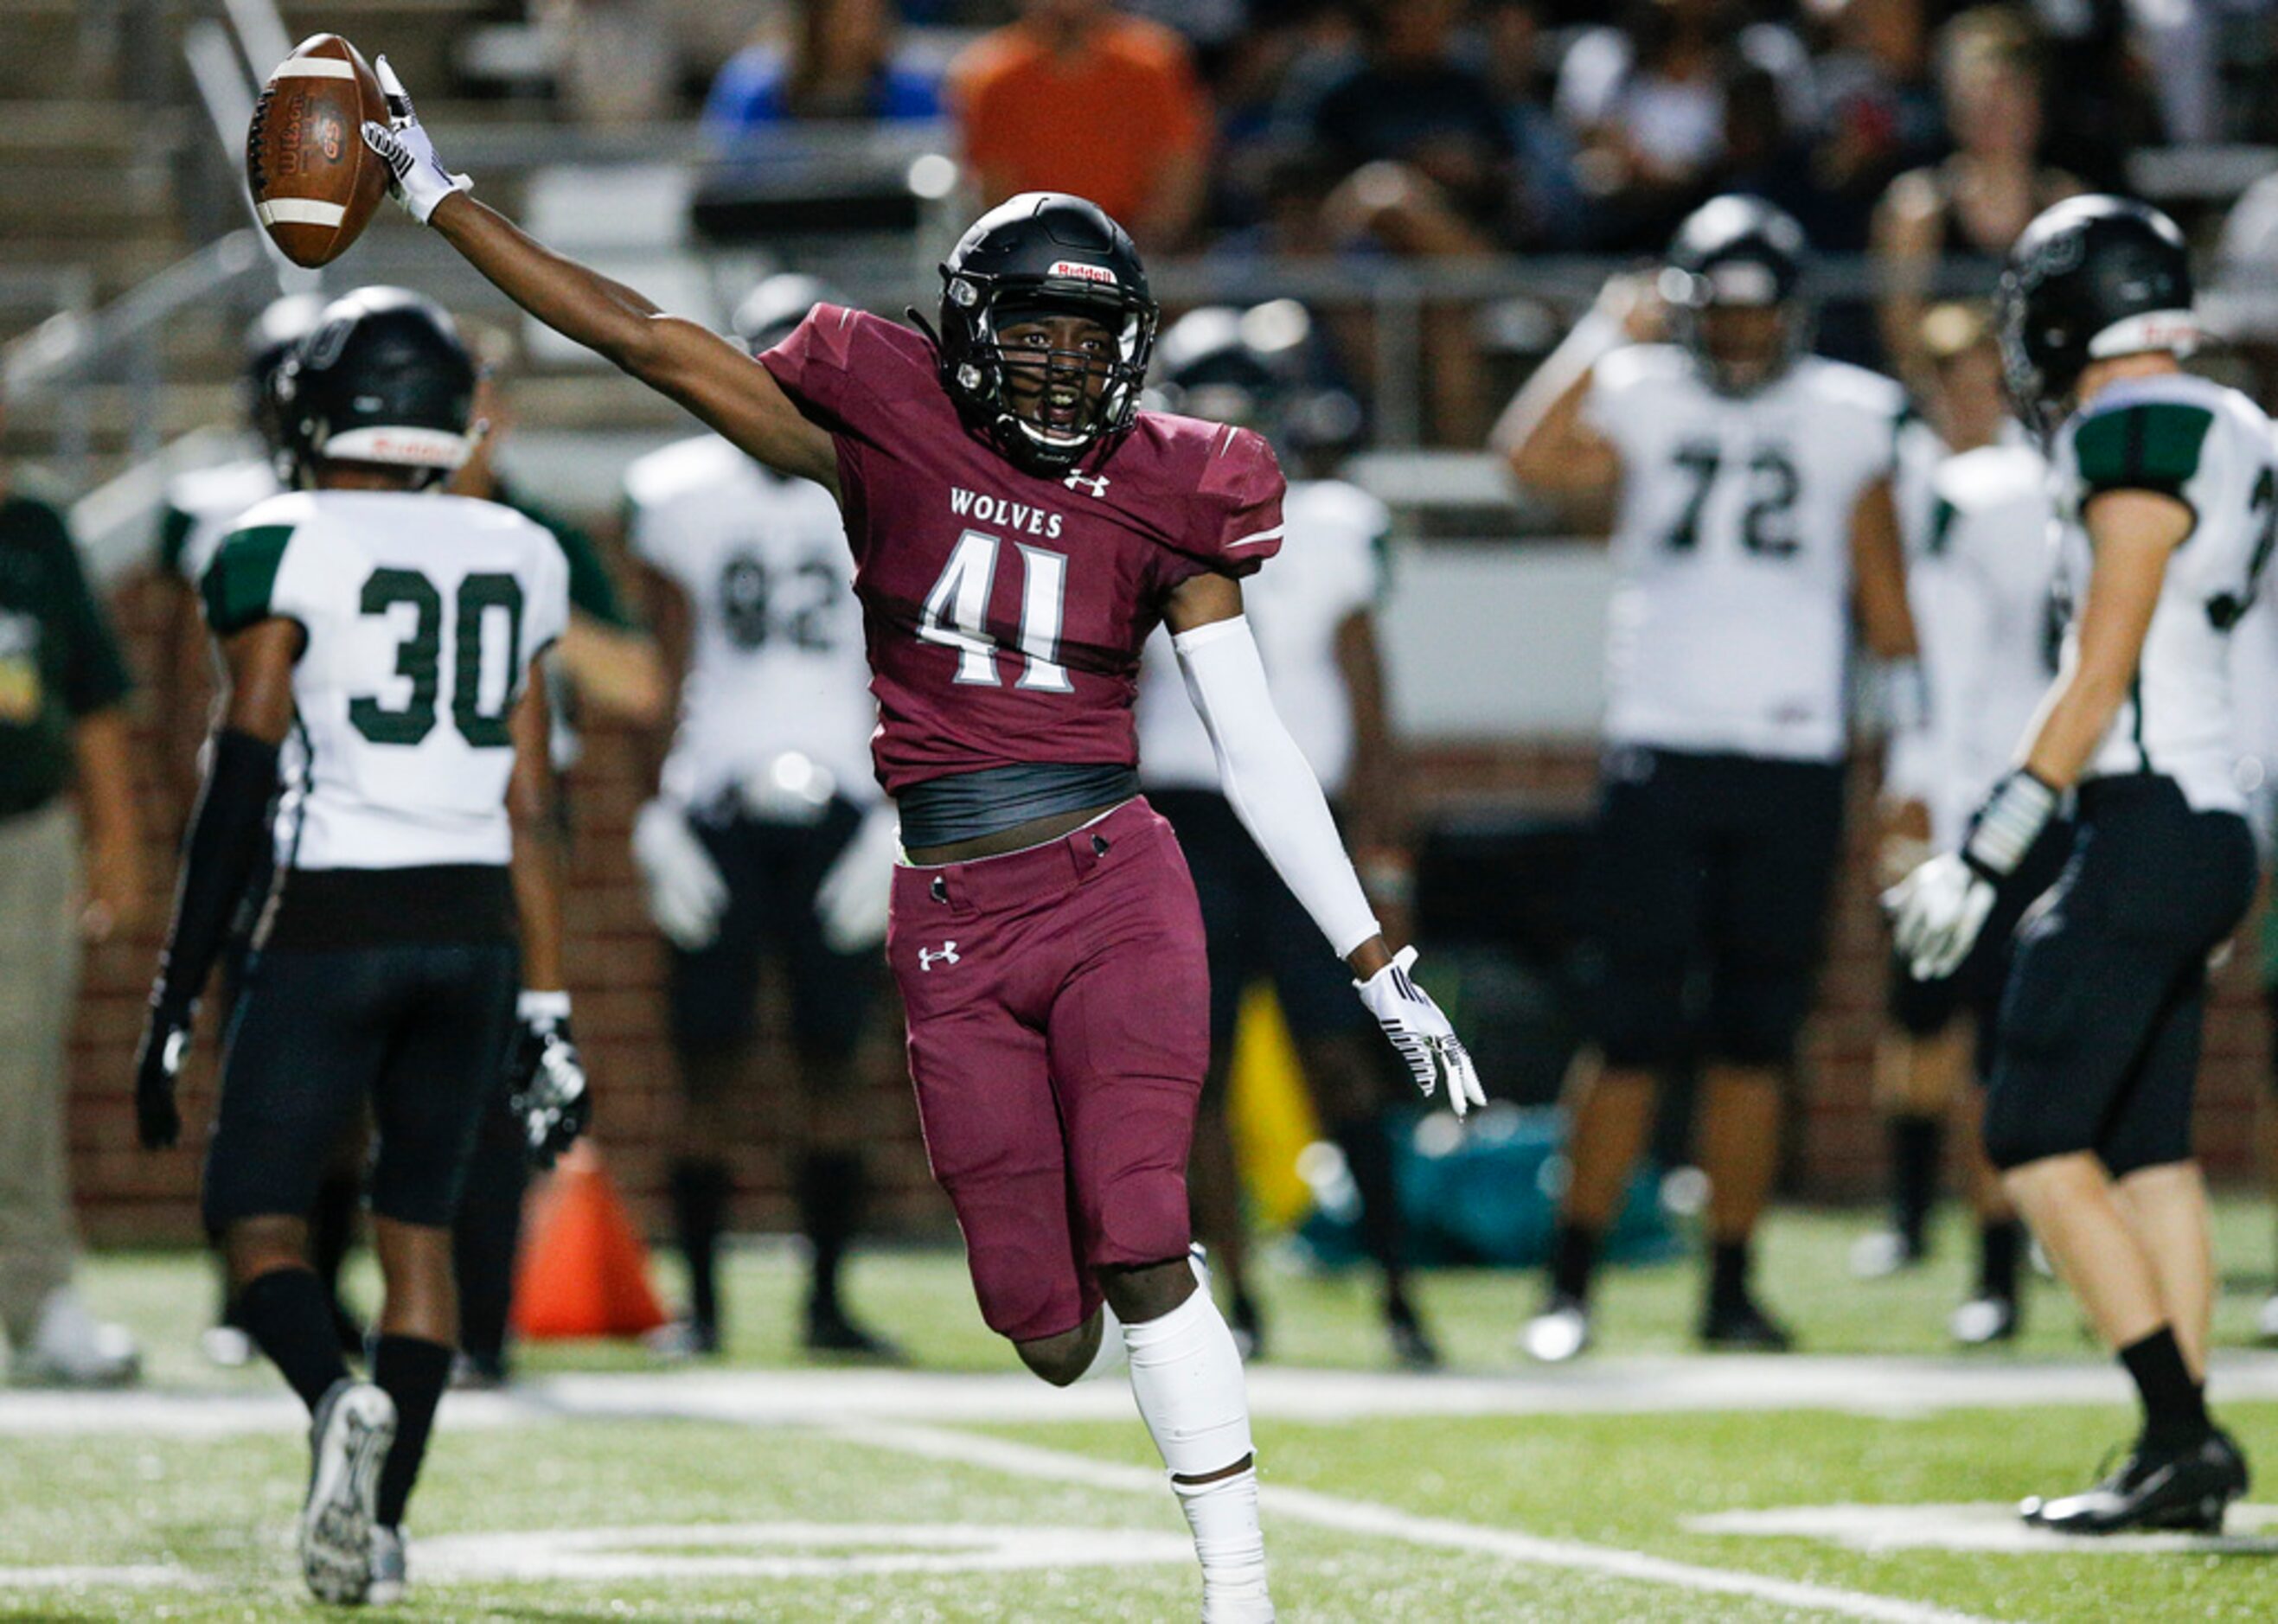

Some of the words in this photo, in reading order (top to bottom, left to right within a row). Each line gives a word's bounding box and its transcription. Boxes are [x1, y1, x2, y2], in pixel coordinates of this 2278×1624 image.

[1058, 262, 1111, 283] Riddell
[951, 487, 1062, 539] WOLVES
[1664, 443, 1801, 554] 72
[349, 567, 524, 747] 30
[916, 528, 1075, 693] 41
